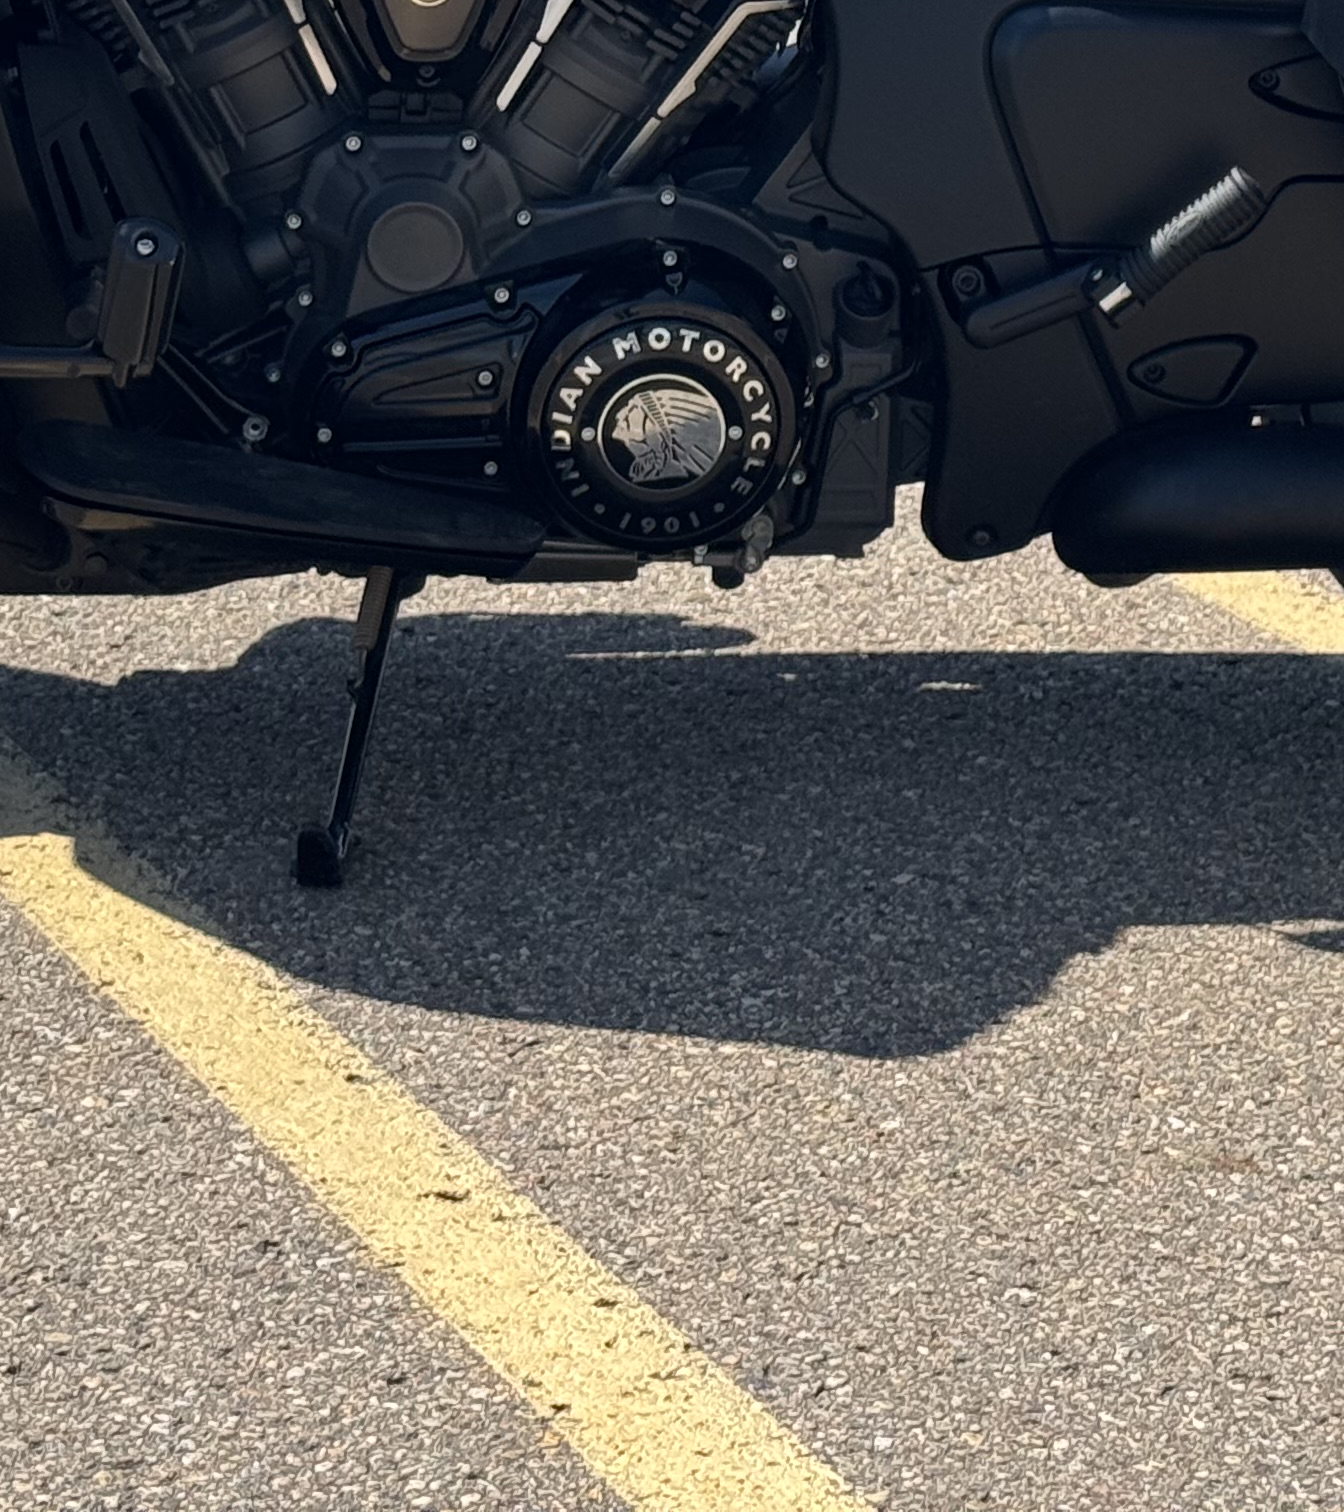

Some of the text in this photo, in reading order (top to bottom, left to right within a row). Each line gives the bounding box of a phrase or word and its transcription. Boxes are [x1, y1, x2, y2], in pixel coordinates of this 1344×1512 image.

[551, 327, 773, 498] INDIAN MOTORCYCLE
[619, 511, 700, 534] 1901
